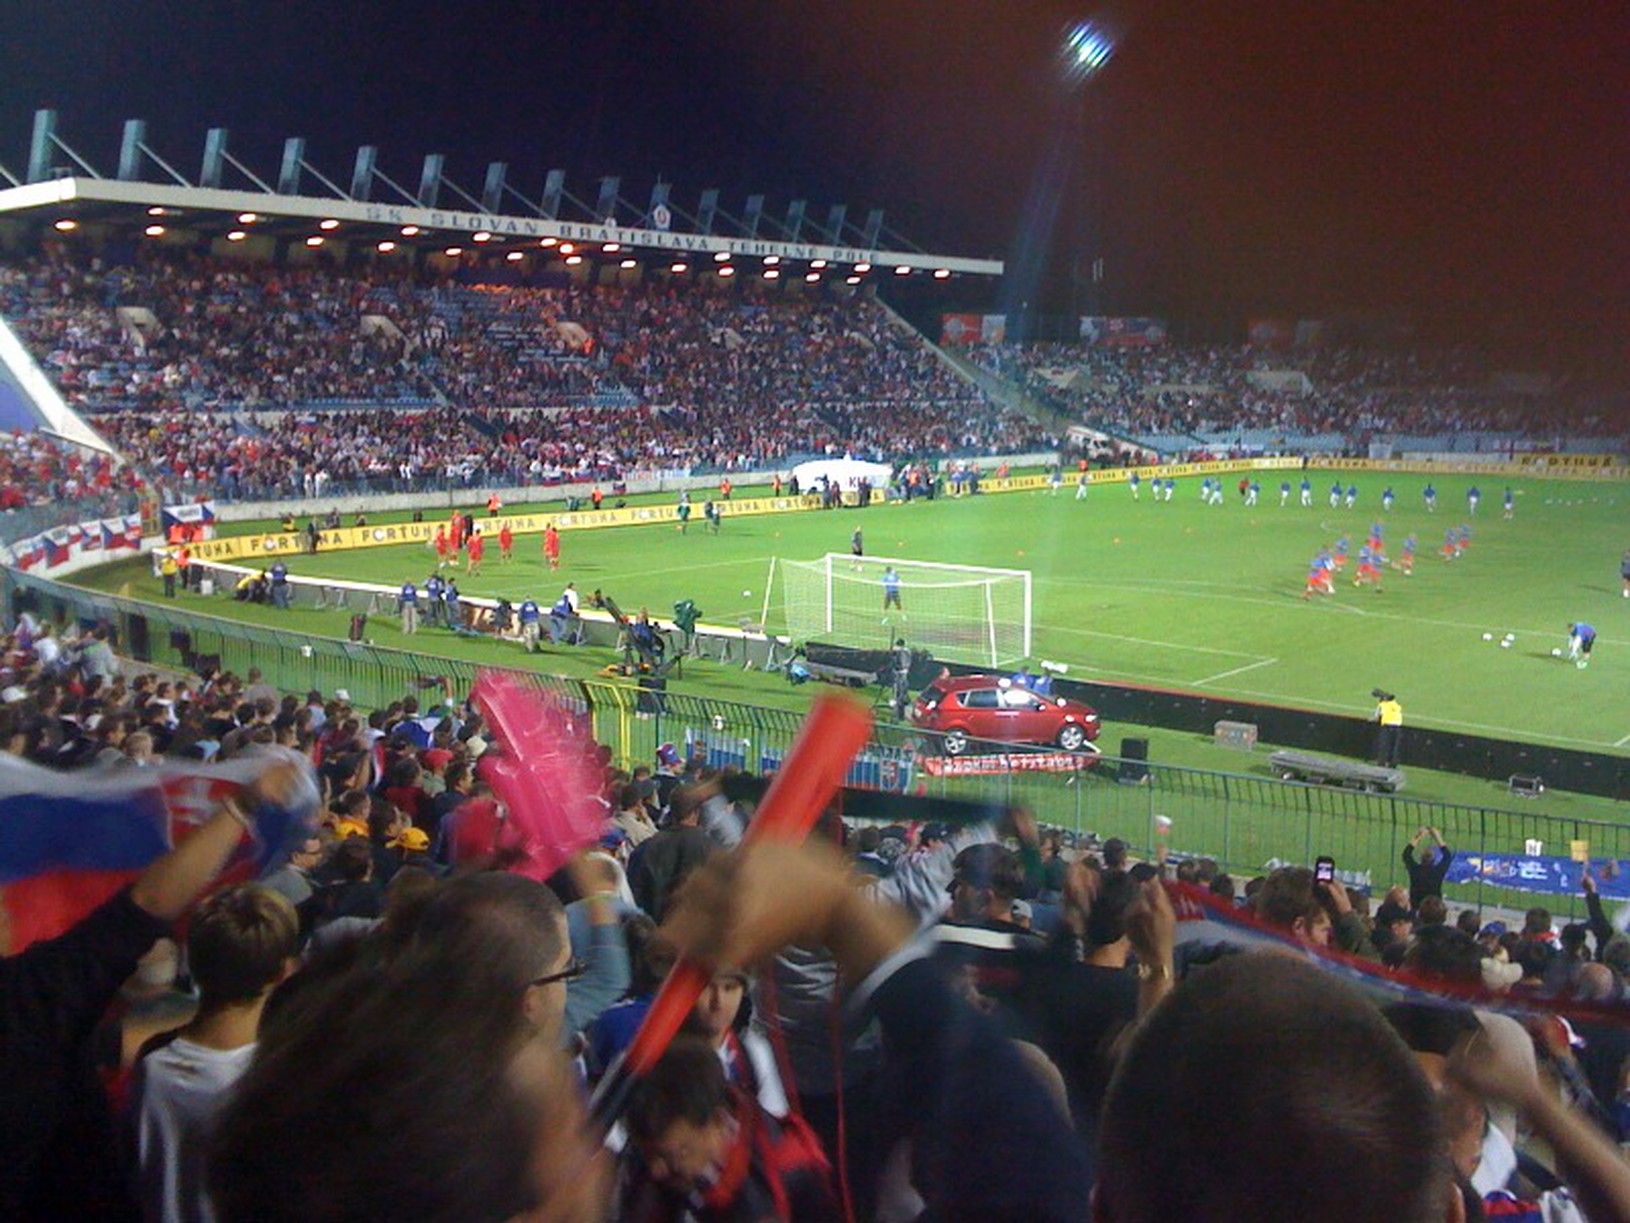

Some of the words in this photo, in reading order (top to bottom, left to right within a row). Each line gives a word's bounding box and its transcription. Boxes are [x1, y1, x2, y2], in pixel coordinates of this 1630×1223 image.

[366, 207, 403, 223] SK
[431, 212, 539, 236] SLOVAN
[559, 225, 709, 250] BRATISLAVA
[832, 249, 879, 263] POLE
[551, 511, 617, 527] FORTUNA
[631, 507, 676, 521] FORTU
[250, 532, 343, 551] FORTNA
[362, 525, 433, 542] FORTUN
